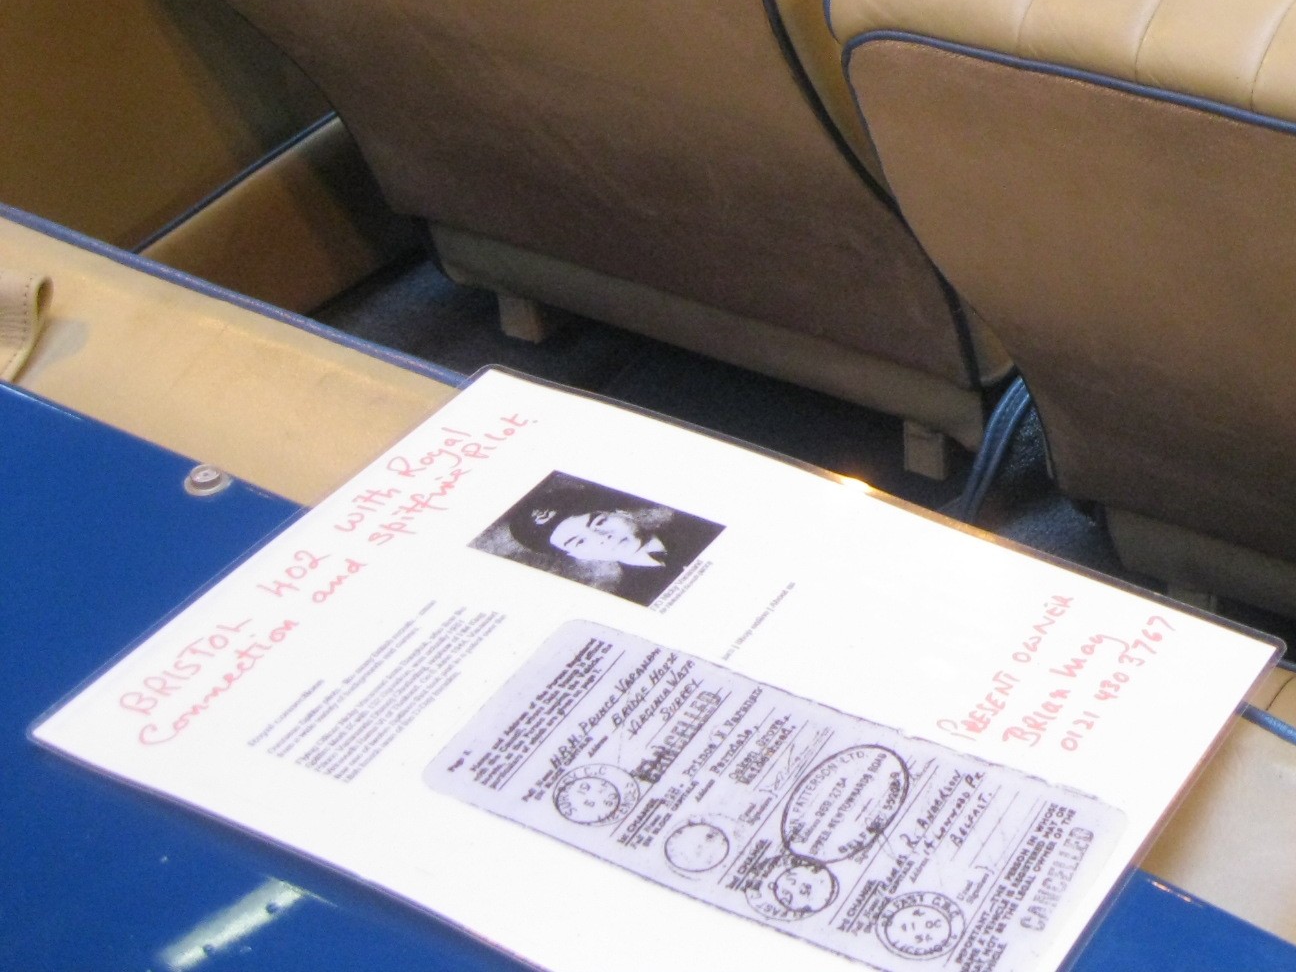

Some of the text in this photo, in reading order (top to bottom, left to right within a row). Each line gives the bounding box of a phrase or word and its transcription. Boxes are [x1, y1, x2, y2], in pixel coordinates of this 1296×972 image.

[119, 427, 478, 717] BRISTOL 402 with Royal
[138, 618, 299, 748] Connection
[311, 557, 365, 605] and
[1060, 710, 1101, 754] 0121
[1117, 615, 1176, 668] 3767
[1018, 824, 1096, 935] CANCELLED
